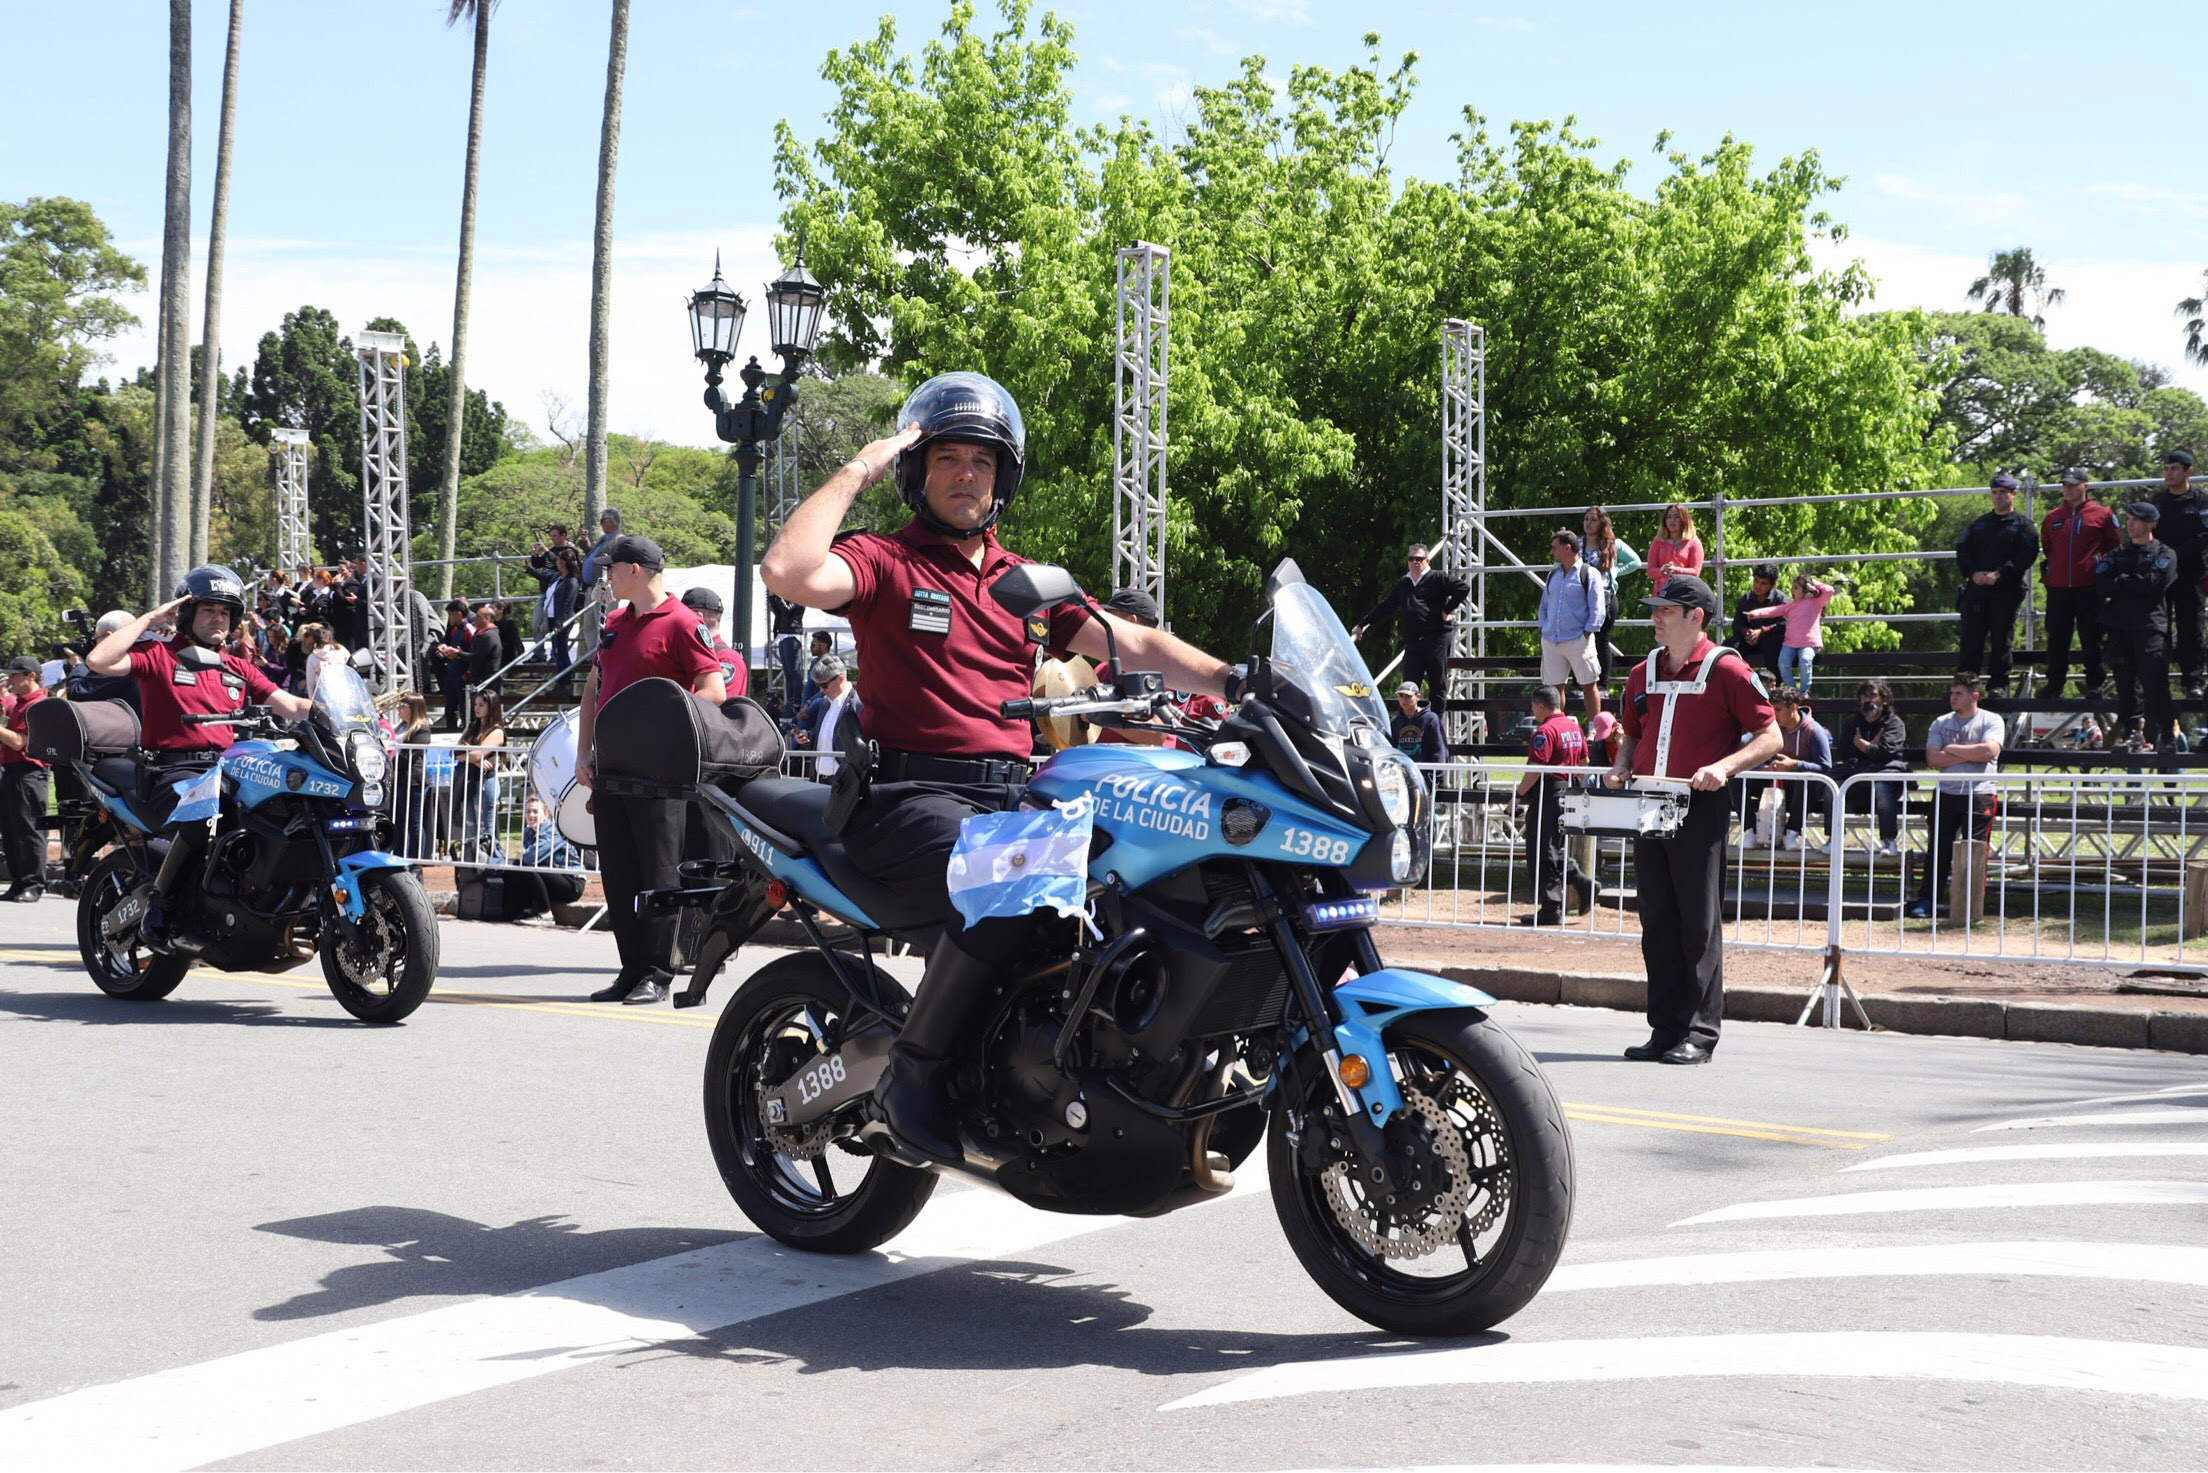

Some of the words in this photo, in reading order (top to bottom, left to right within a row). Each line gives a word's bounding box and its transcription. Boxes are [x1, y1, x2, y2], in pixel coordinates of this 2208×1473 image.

[233, 754, 283, 778] POLICIA
[740, 748, 764, 766] 1388
[230, 766, 240, 778] DE
[240, 769, 249, 780] LA
[249, 772, 281, 789] CIUDAD
[308, 780, 340, 796] 1732
[1094, 773, 1212, 819] POLICIA
[1236, 798, 1265, 812] POLICIA
[1112, 801, 1135, 824] LA
[1138, 808, 1209, 841] CIUDAD
[750, 834, 775, 867] 911
[1280, 827, 1350, 865] 1388
[117, 899, 141, 925] 1732
[797, 1054, 847, 1105] 1388
